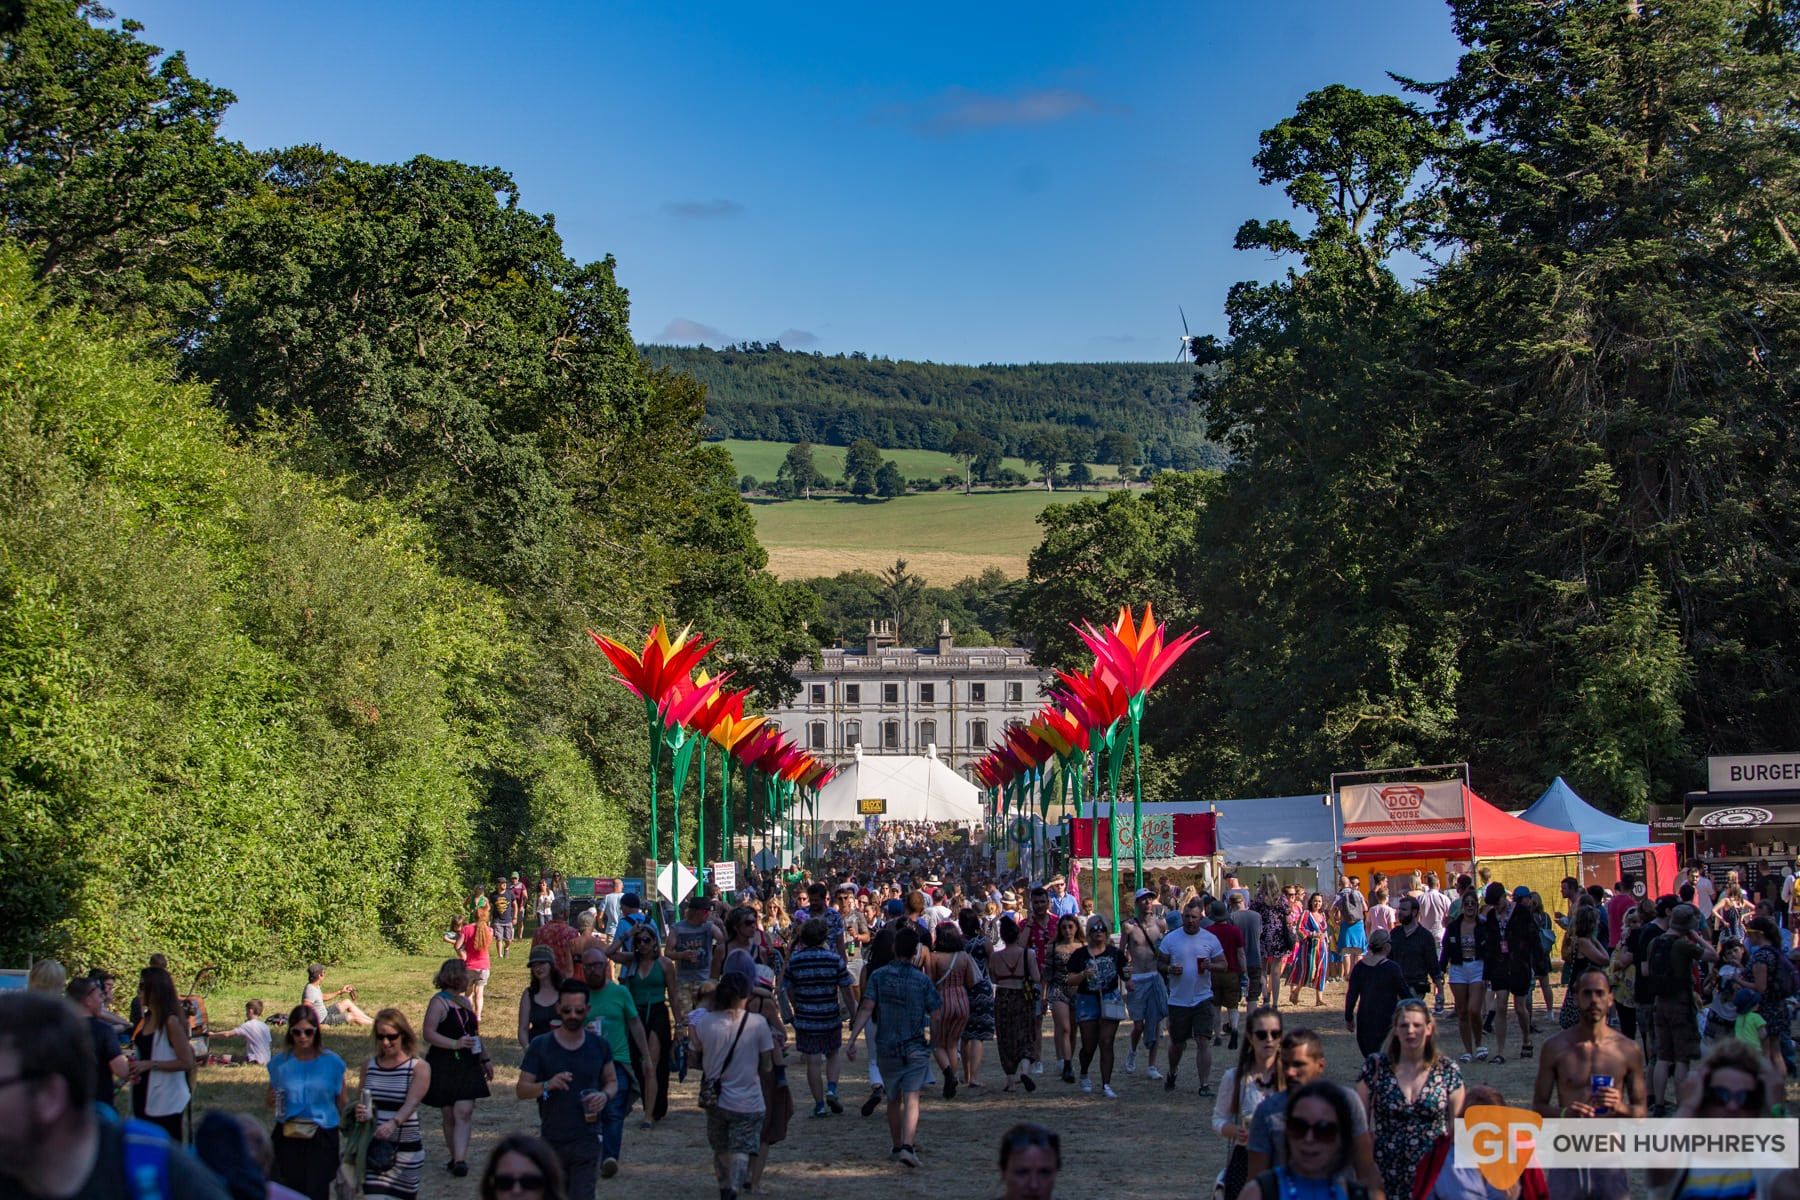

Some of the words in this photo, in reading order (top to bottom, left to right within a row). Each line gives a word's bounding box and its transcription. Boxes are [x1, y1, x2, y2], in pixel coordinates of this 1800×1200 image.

[1389, 795, 1417, 807] DOG
[1390, 811, 1419, 819] HOUSE
[1118, 820, 1169, 848] Gtter
